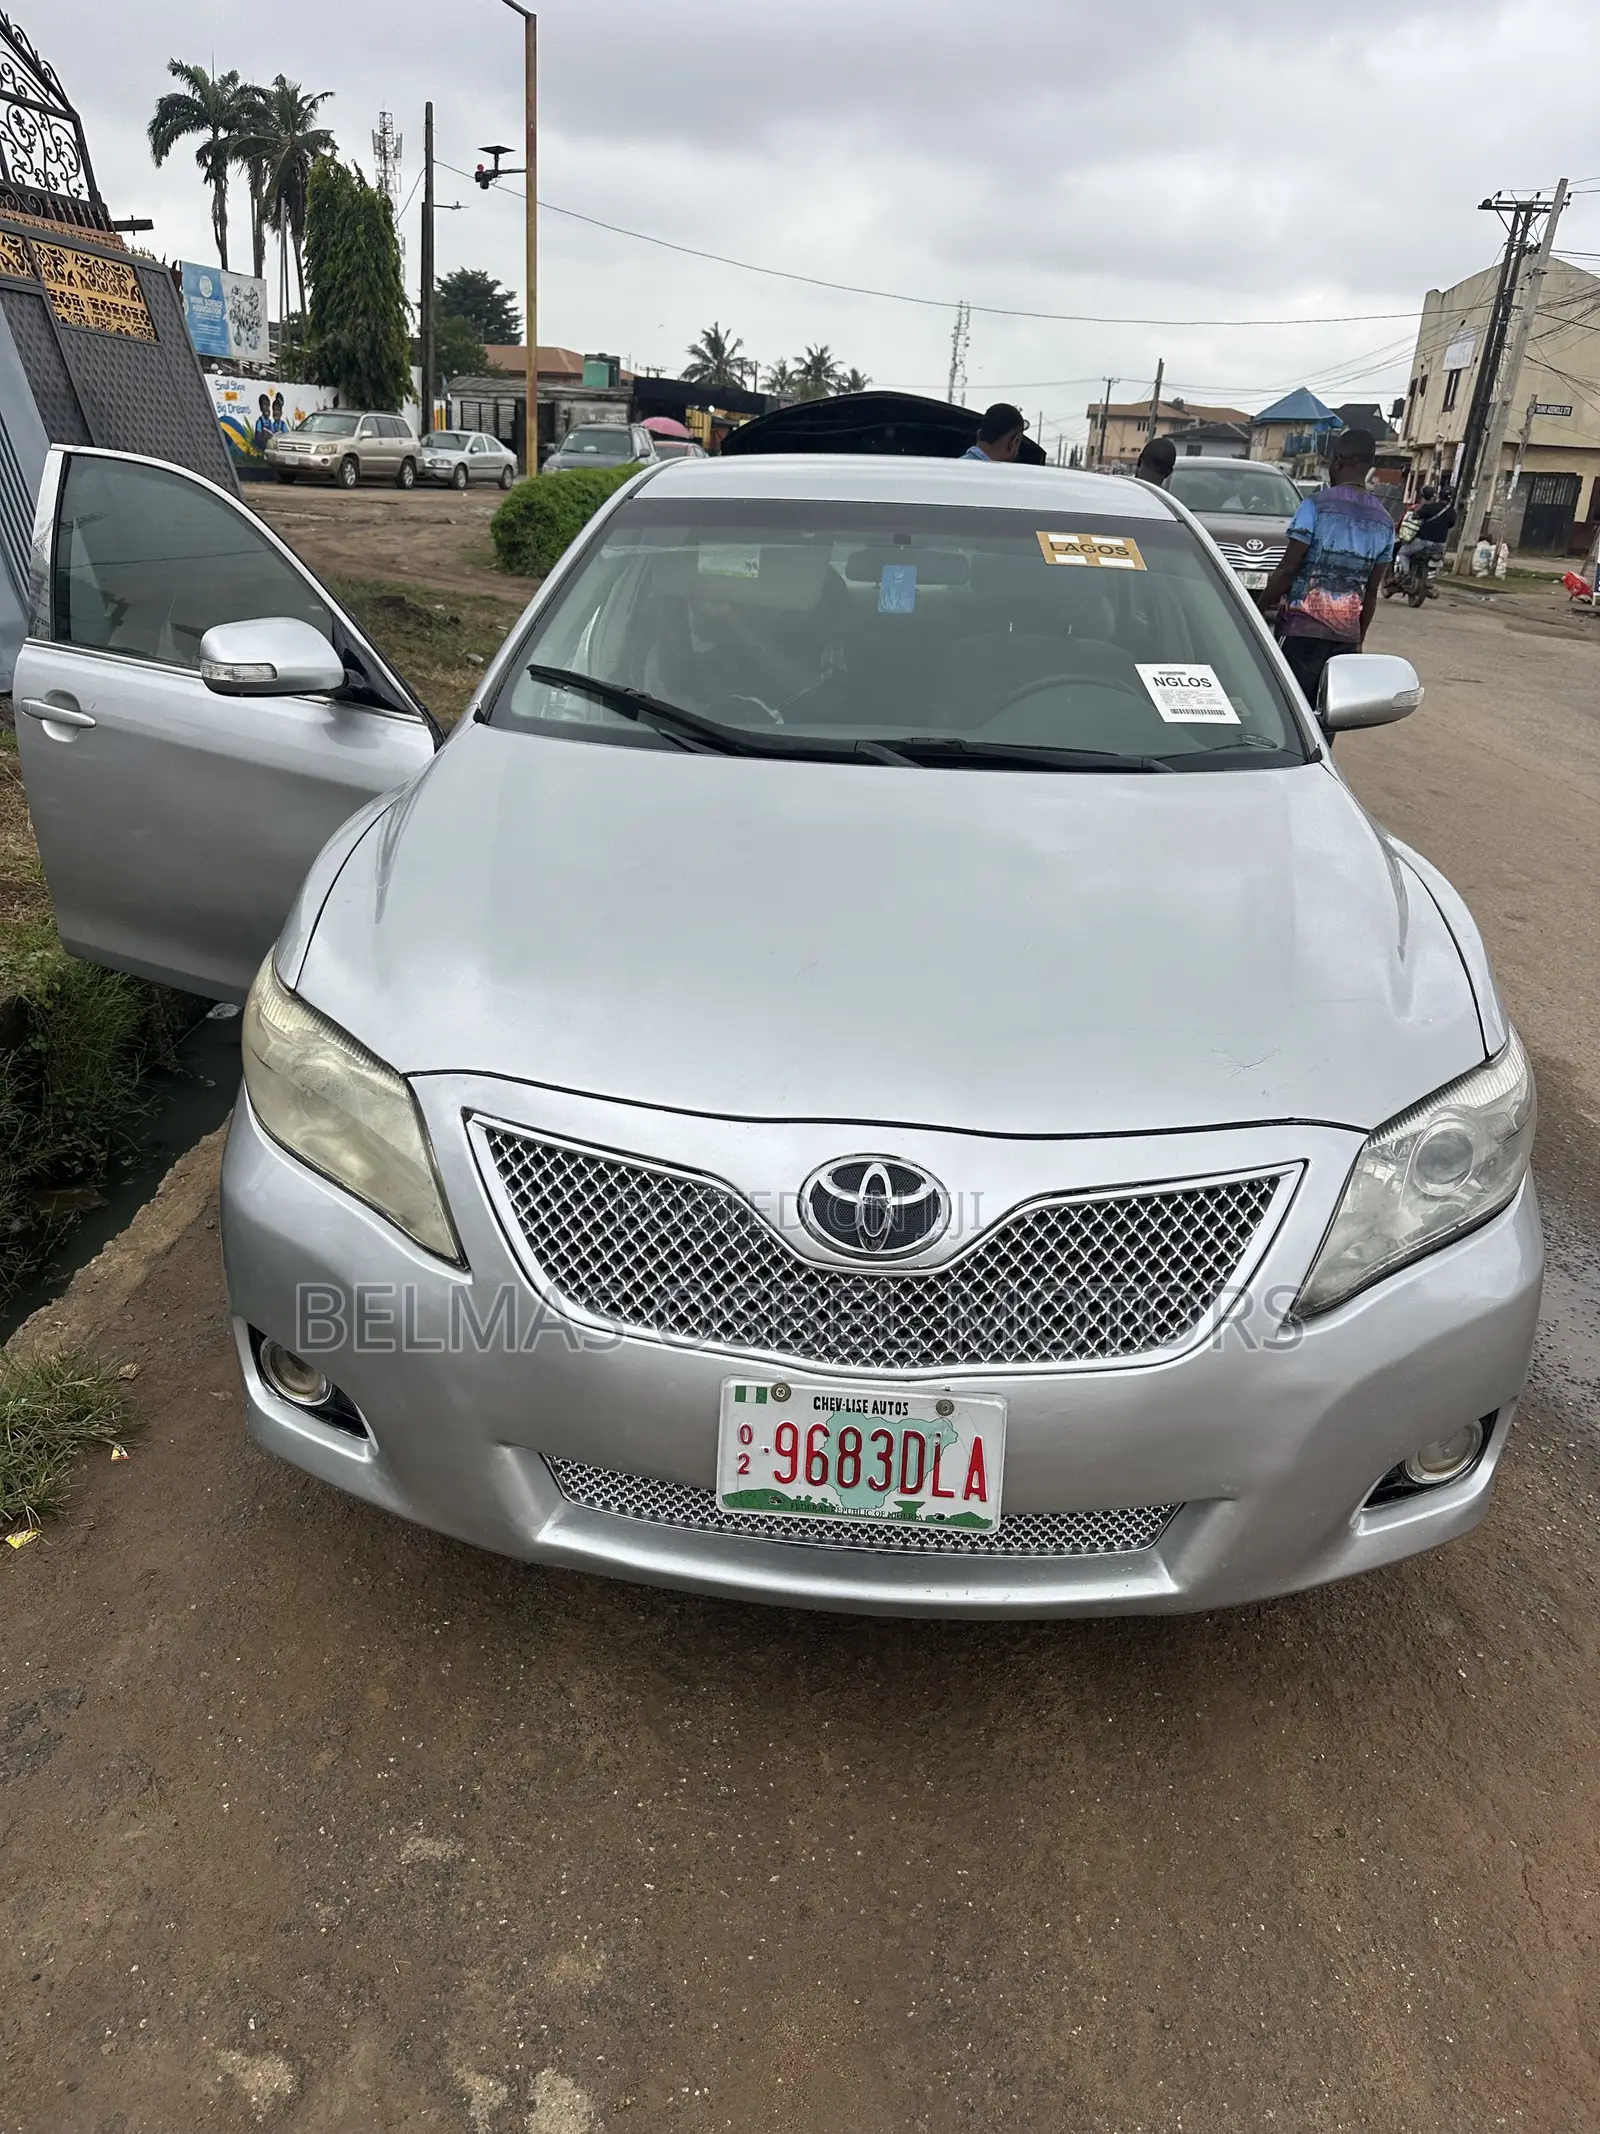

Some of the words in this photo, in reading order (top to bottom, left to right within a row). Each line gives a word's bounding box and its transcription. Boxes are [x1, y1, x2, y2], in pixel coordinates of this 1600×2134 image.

[216, 402, 227, 416] Big
[228, 403, 251, 415] Dreams
[1049, 541, 1130, 556] LAGOS
[1152, 676, 1212, 688] NGLOS
[871, 1400, 909, 1416] AUTOS
[772, 1420, 988, 1503] 9683DLA
[790, 1503, 828, 1513] FEDERAL
[831, 1505, 873, 1517] REPUBLIC
[874, 1510, 886, 1518] OF
[887, 1511, 923, 1521] NIGERIA
